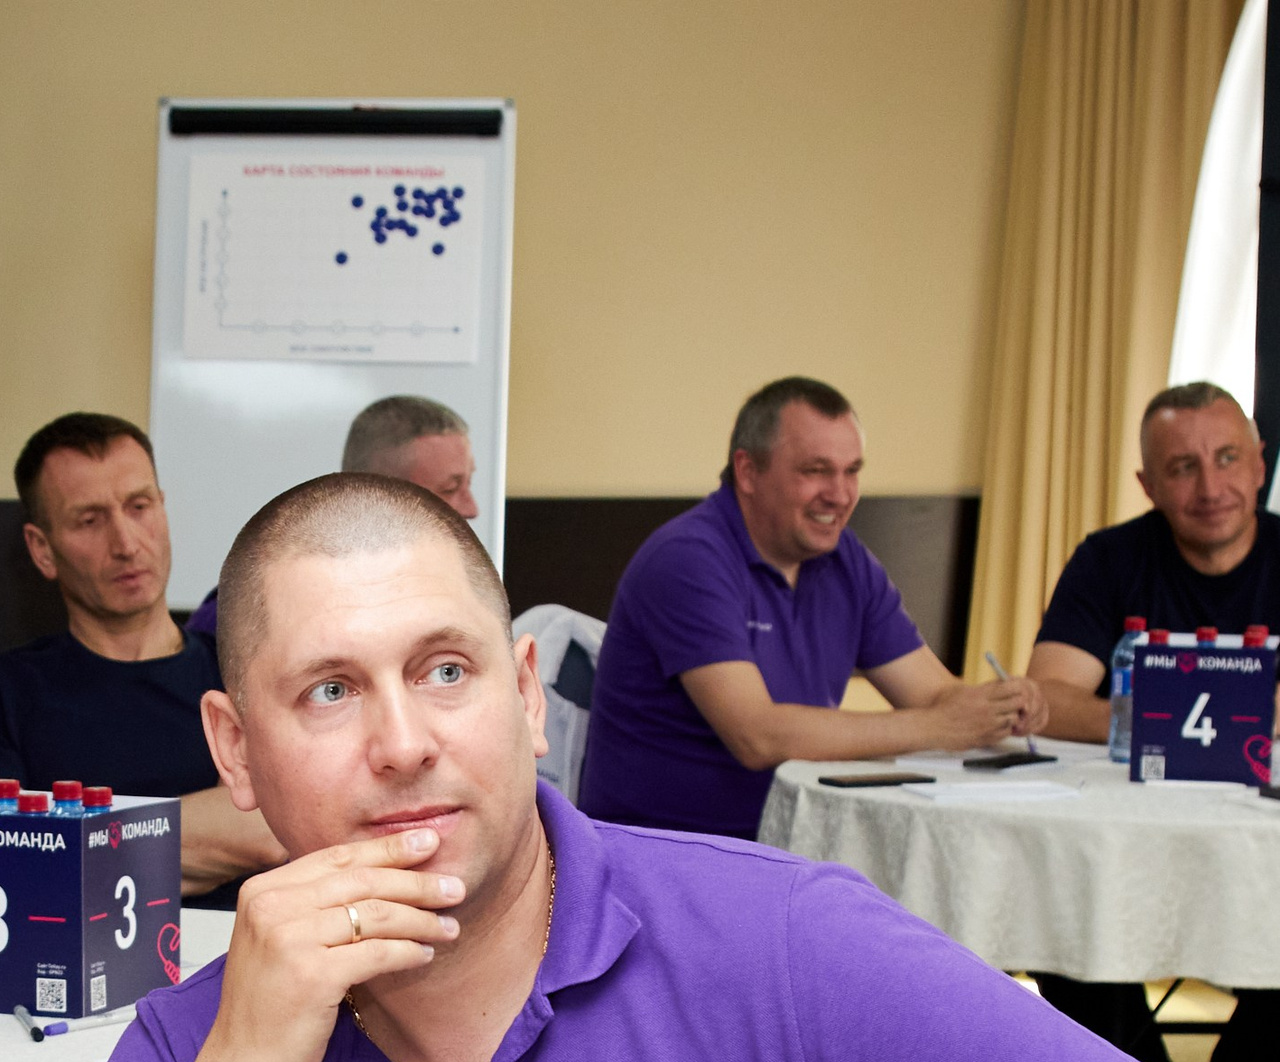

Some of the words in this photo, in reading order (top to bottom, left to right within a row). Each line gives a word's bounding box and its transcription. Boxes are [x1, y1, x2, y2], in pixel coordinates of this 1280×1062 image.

[1145, 654, 1176, 668] #МЫ
[1198, 656, 1262, 672] КОМАНДА
[1181, 692, 1217, 747] 4
[88, 830, 109, 848] #МЫ
[122, 817, 170, 840] КОМАНДА
[114, 875, 138, 950] 3
